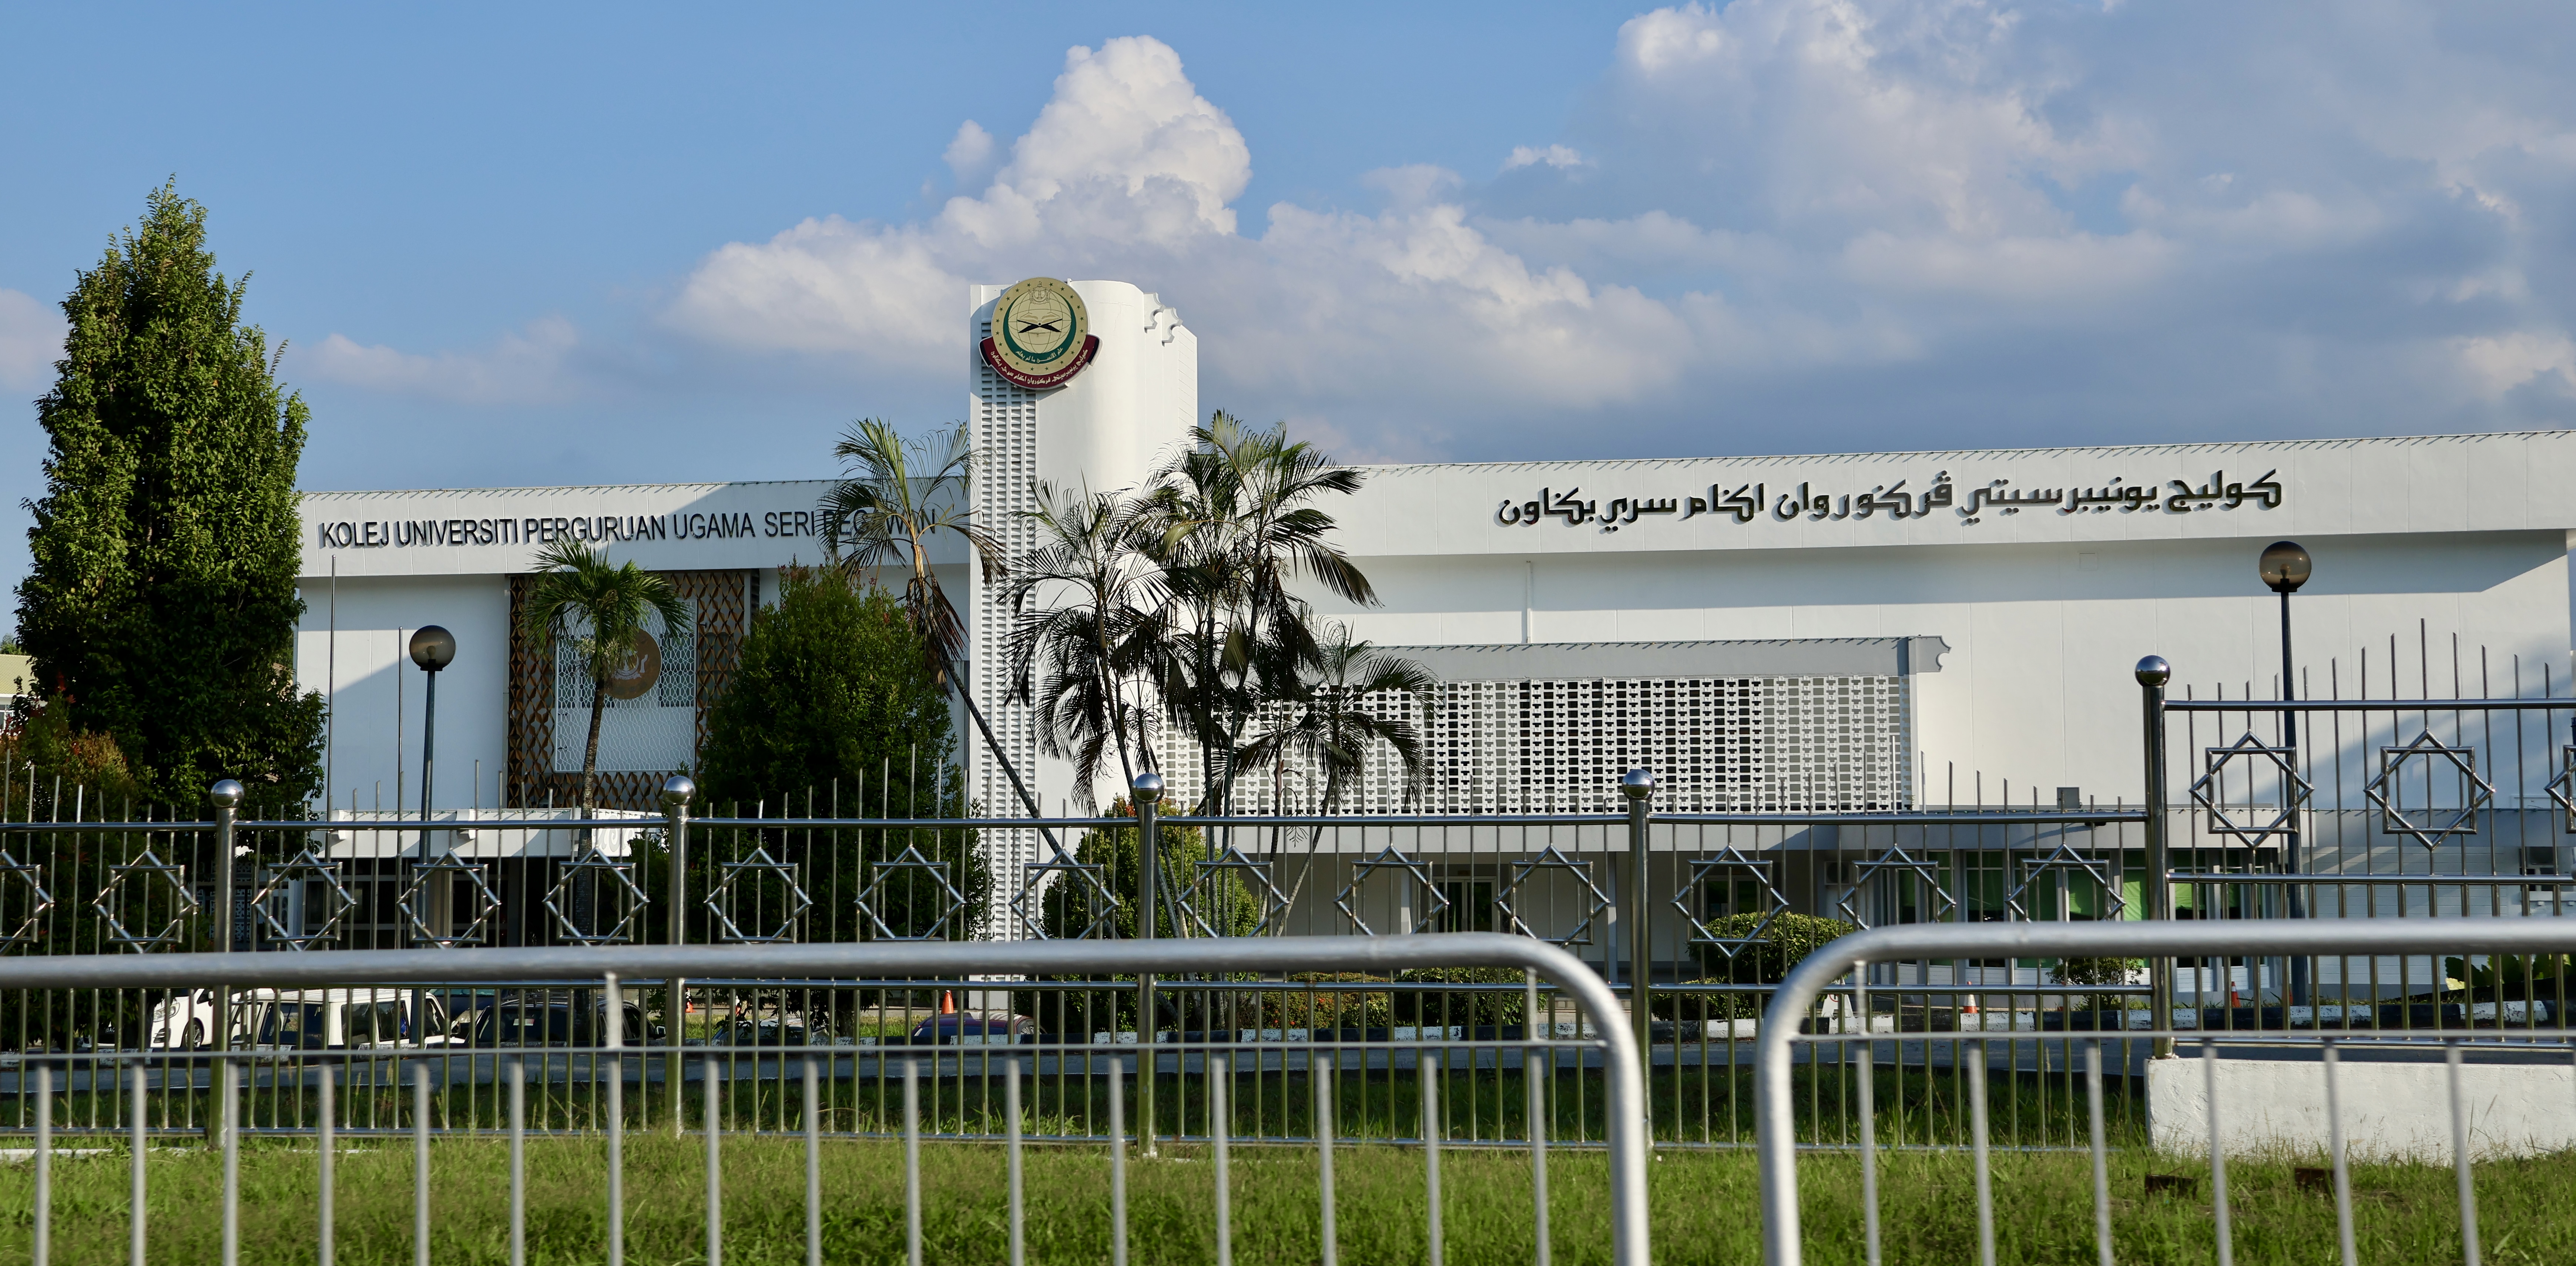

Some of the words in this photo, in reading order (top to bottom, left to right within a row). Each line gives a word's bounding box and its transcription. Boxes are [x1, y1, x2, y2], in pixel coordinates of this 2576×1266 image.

[322, 521, 389, 547] KOLEJ
[397, 518, 518, 545] UNIVERSITI
[526, 515, 666, 544] PERGURUAN
[674, 512, 756, 540] UGAMA
[765, 511, 815, 537] SERI
